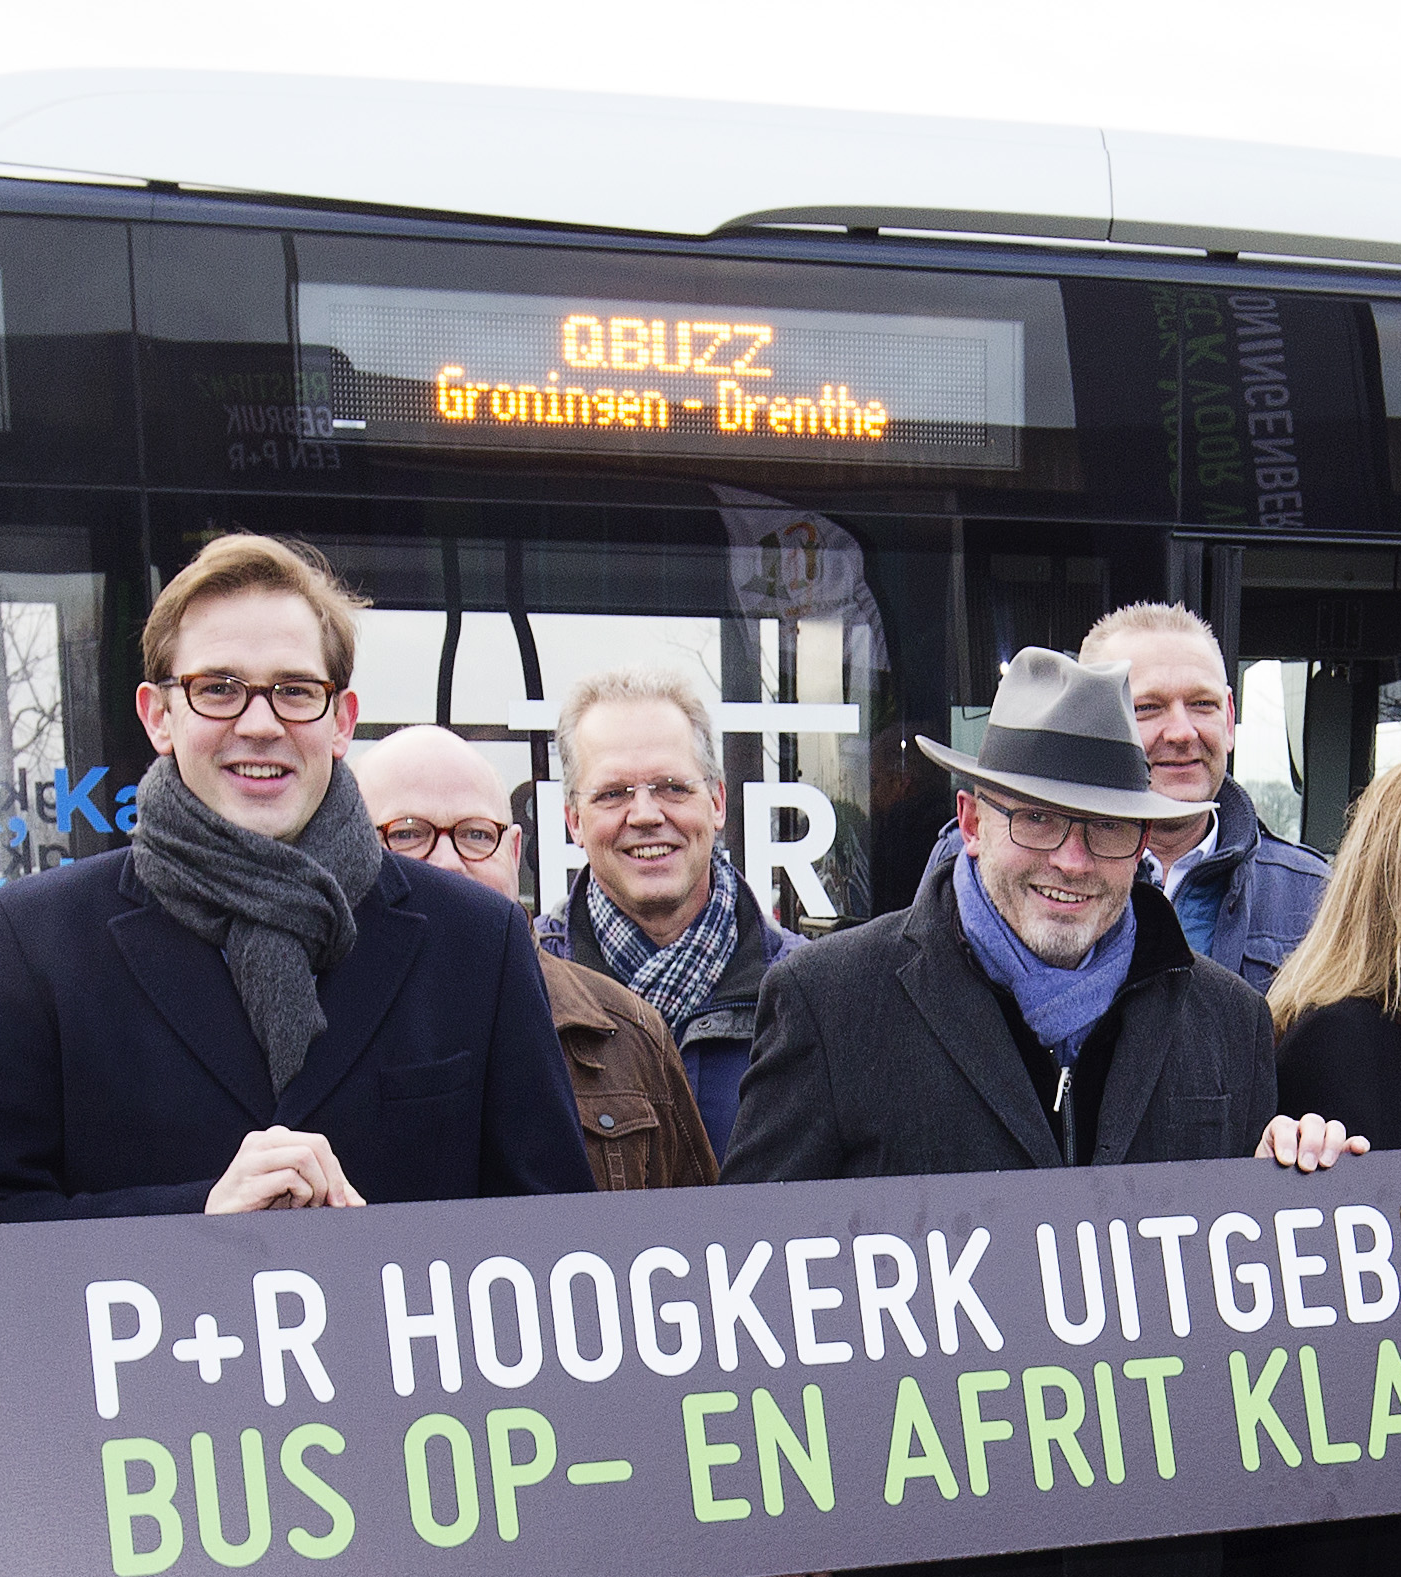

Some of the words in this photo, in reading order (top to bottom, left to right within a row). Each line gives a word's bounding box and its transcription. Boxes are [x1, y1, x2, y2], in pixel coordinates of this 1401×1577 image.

[437, 366, 669, 428] Groningen
[717, 379, 889, 437] Drenthe
[564, 315, 773, 377] QBUZZ
[85, 1269, 336, 1420] P+R
[380, 1226, 1005, 1398] HOOGKERK
[101, 1422, 357, 1577] BUS
[682, 1383, 837, 1523] EN
[884, 1356, 1185, 1506] AFRIT
